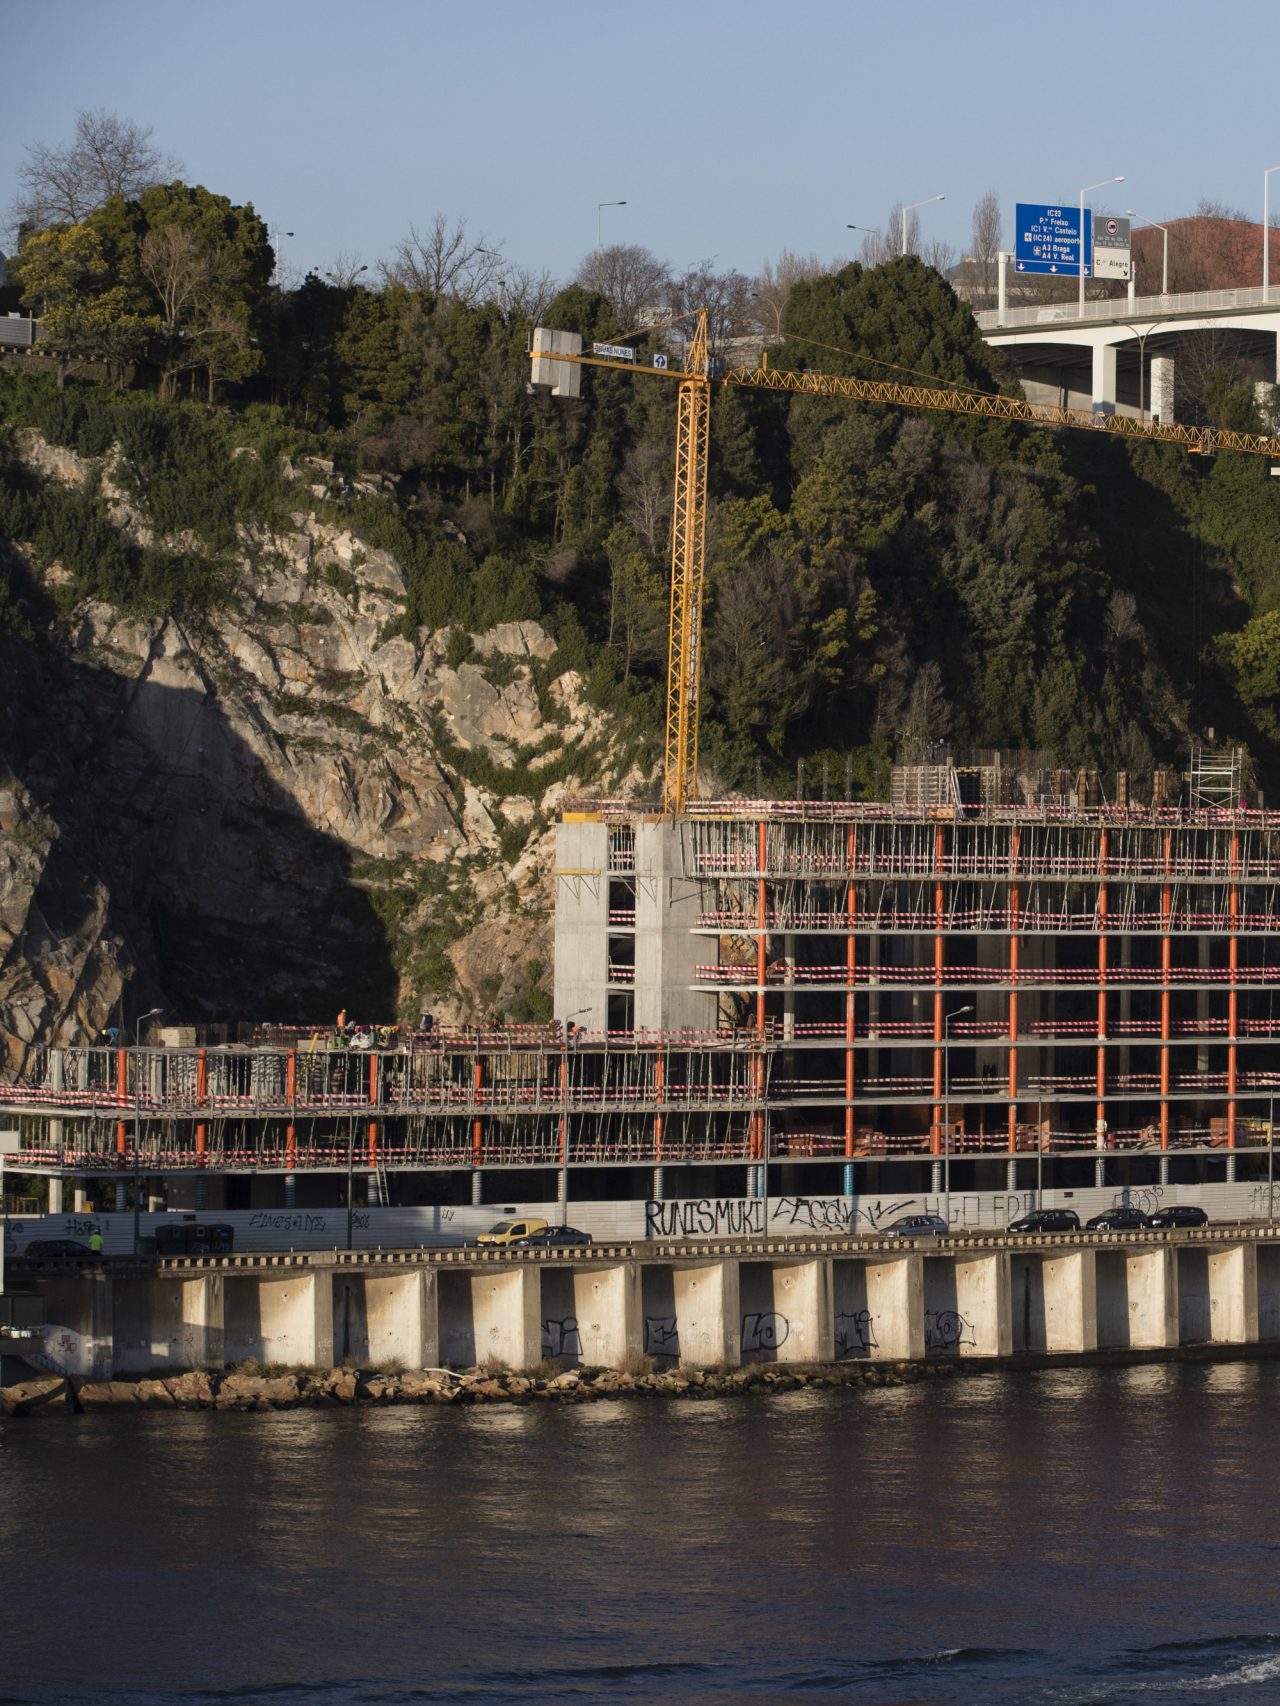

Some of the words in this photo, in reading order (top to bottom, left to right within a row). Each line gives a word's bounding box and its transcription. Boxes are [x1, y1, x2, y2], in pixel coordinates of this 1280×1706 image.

[1047, 209, 1062, 217] IC23
[1050, 218, 1069, 226] Freixo
[1054, 226, 1077, 235] Castelo
[1054, 237, 1081, 245] aeroport
[1053, 245, 1070, 253] Braga
[1061, 253, 1075, 261] Real
[1109, 260, 1129, 269] Alegre
